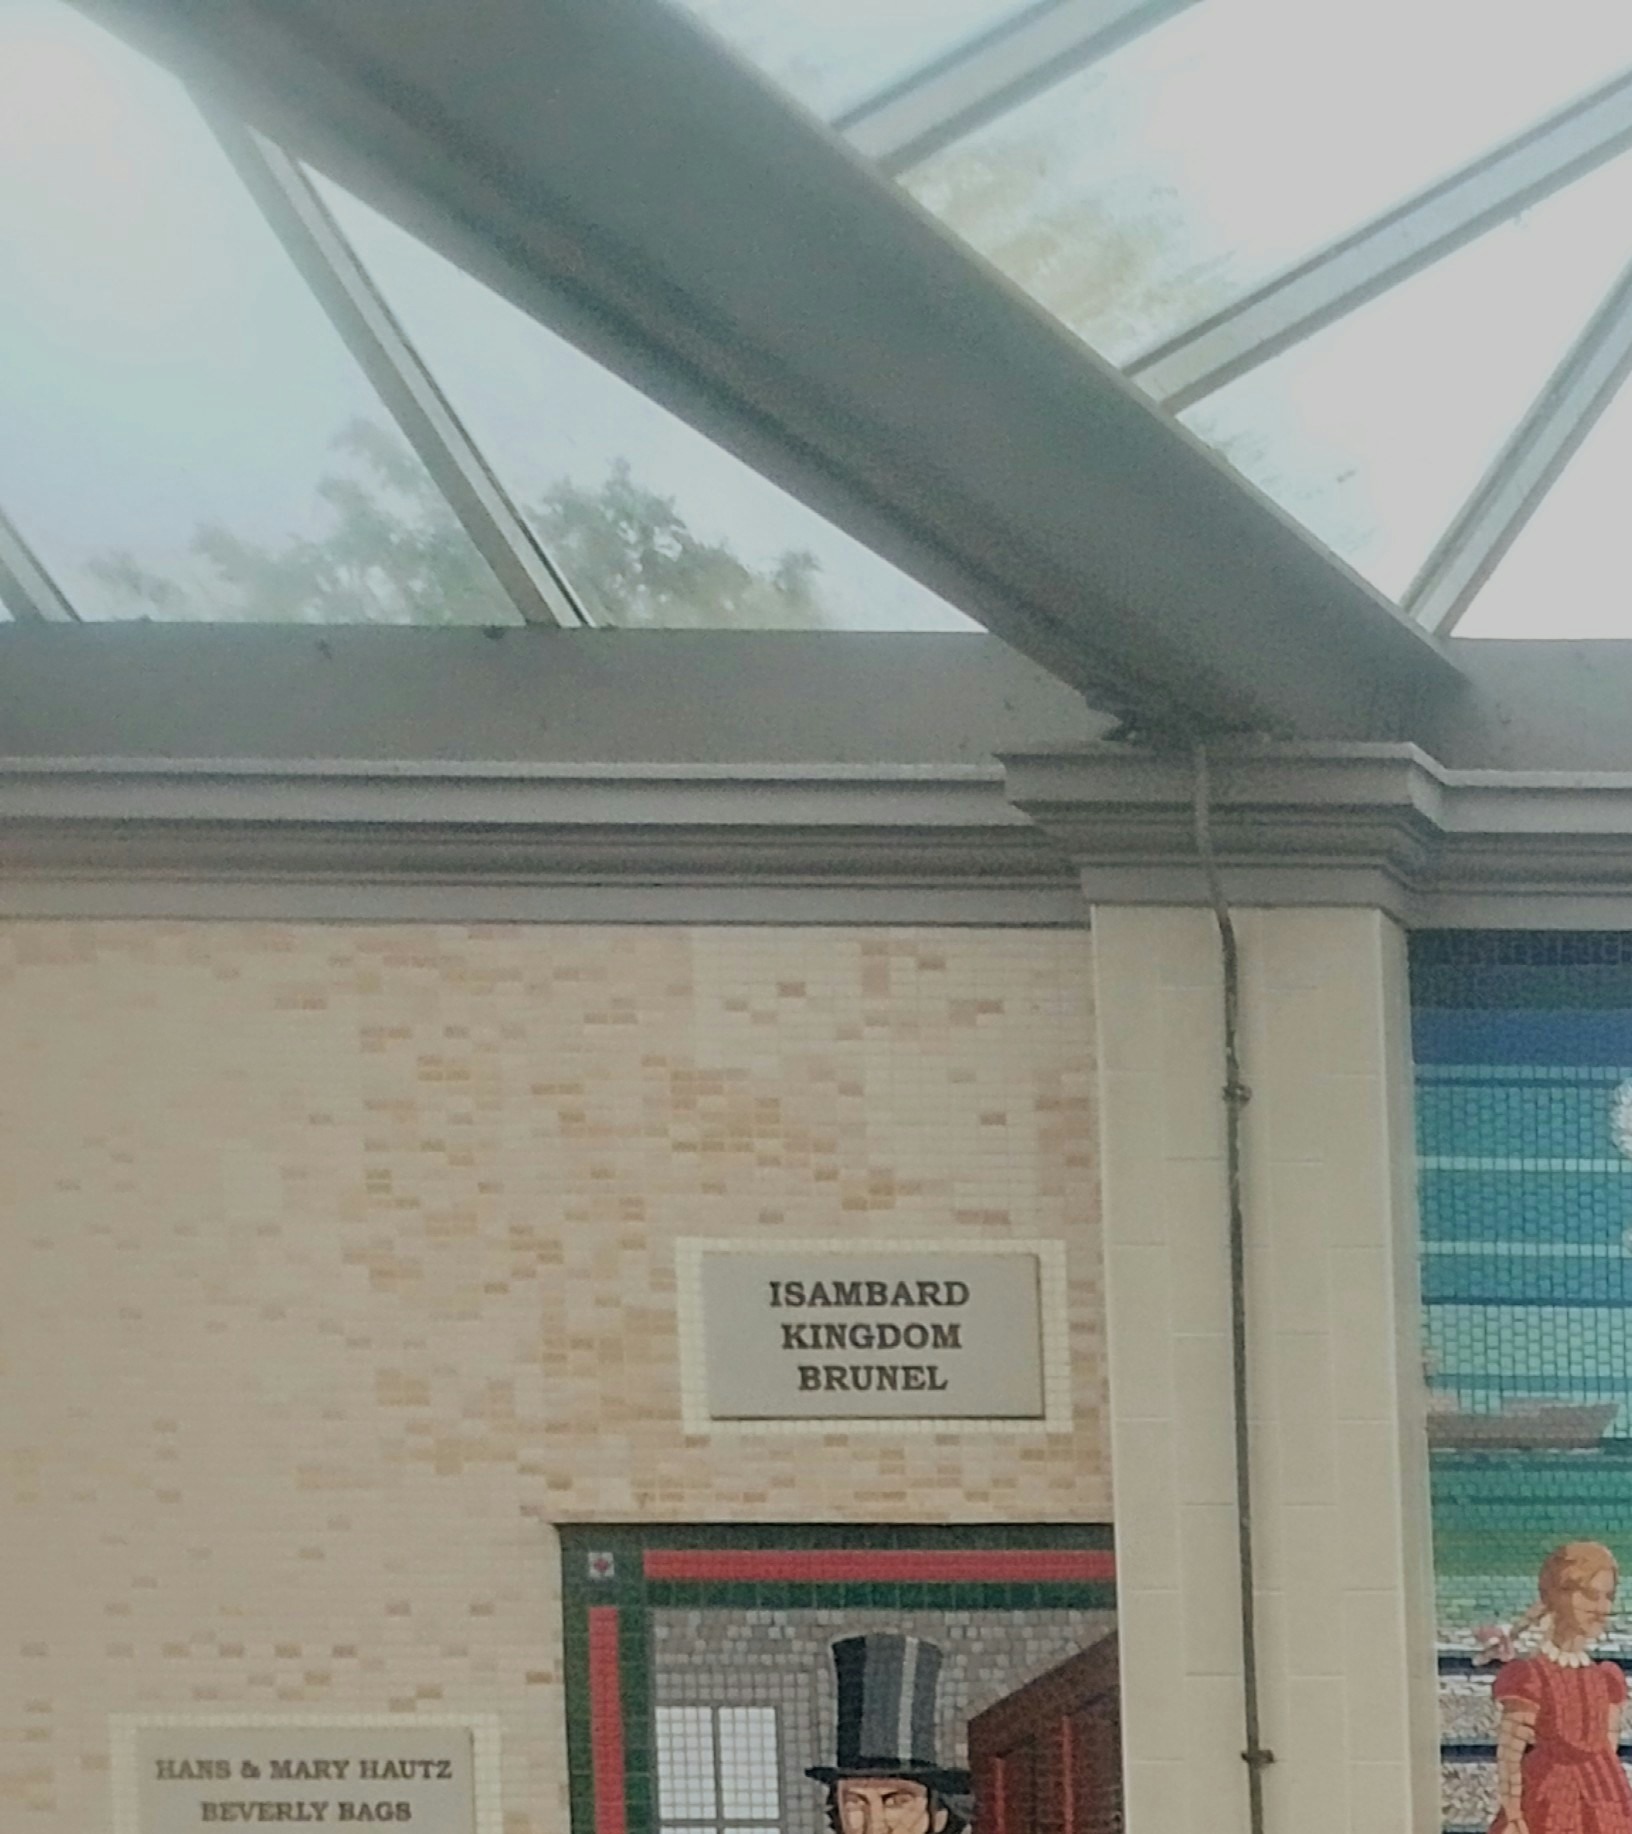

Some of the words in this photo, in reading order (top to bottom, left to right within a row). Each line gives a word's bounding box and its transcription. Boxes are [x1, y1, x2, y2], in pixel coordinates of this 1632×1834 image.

[769, 1281, 970, 1307] ISAMBARD
[781, 1323, 962, 1350] KINGDOM
[798, 1365, 949, 1391] BRUNEL
[156, 1760, 231, 1780] HANS
[241, 1760, 261, 1779] &
[270, 1760, 349, 1780] MARY
[359, 1760, 452, 1780] HAUTZ
[201, 1801, 328, 1822] BEVERLY
[338, 1801, 412, 1822] BAGS
